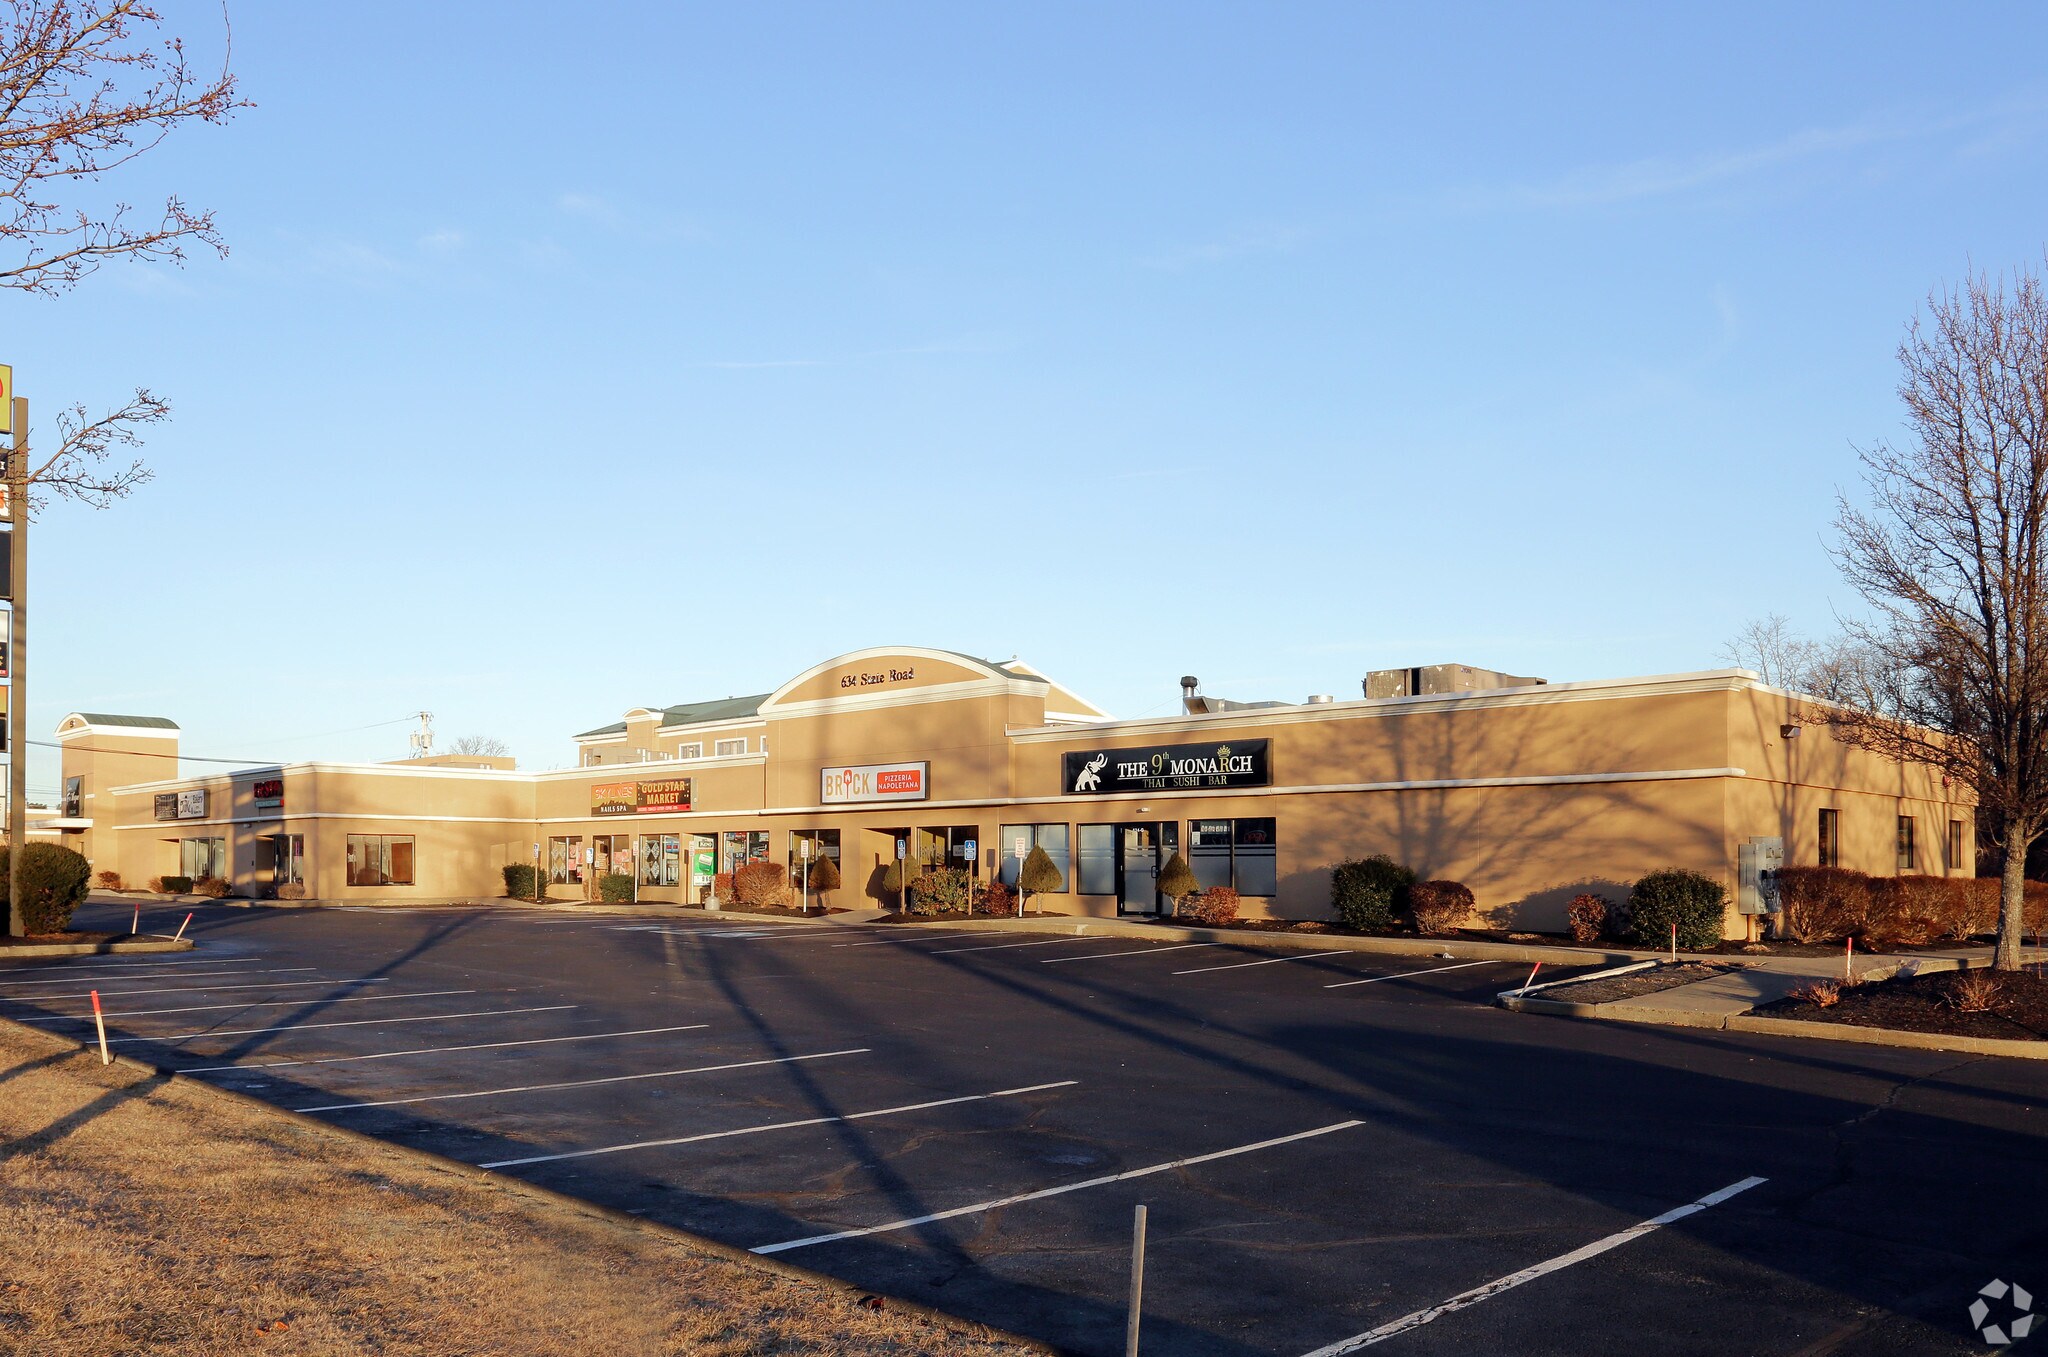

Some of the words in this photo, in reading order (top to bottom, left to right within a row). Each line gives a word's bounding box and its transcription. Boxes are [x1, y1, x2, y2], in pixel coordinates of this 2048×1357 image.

[841, 674, 857, 688] 634
[861, 672, 885, 686] State
[889, 668, 915, 682] Road
[1117, 761, 1148, 778] THE
[1151, 751, 1170, 776] 9th
[1170, 755, 1253, 775] MONARCH
[825, 769, 870, 799] BRICK
[884, 774, 912, 782] PIZZERIA
[1143, 777, 1166, 788] THAI
[1173, 776, 1200, 787] SUSHI
[1208, 775, 1227, 786] BAR
[641, 782, 663, 793] GOLD
[665, 781, 685, 791] STAR
[878, 781, 919, 790] NAPOLETANA
[646, 793, 680, 804] MARKET
